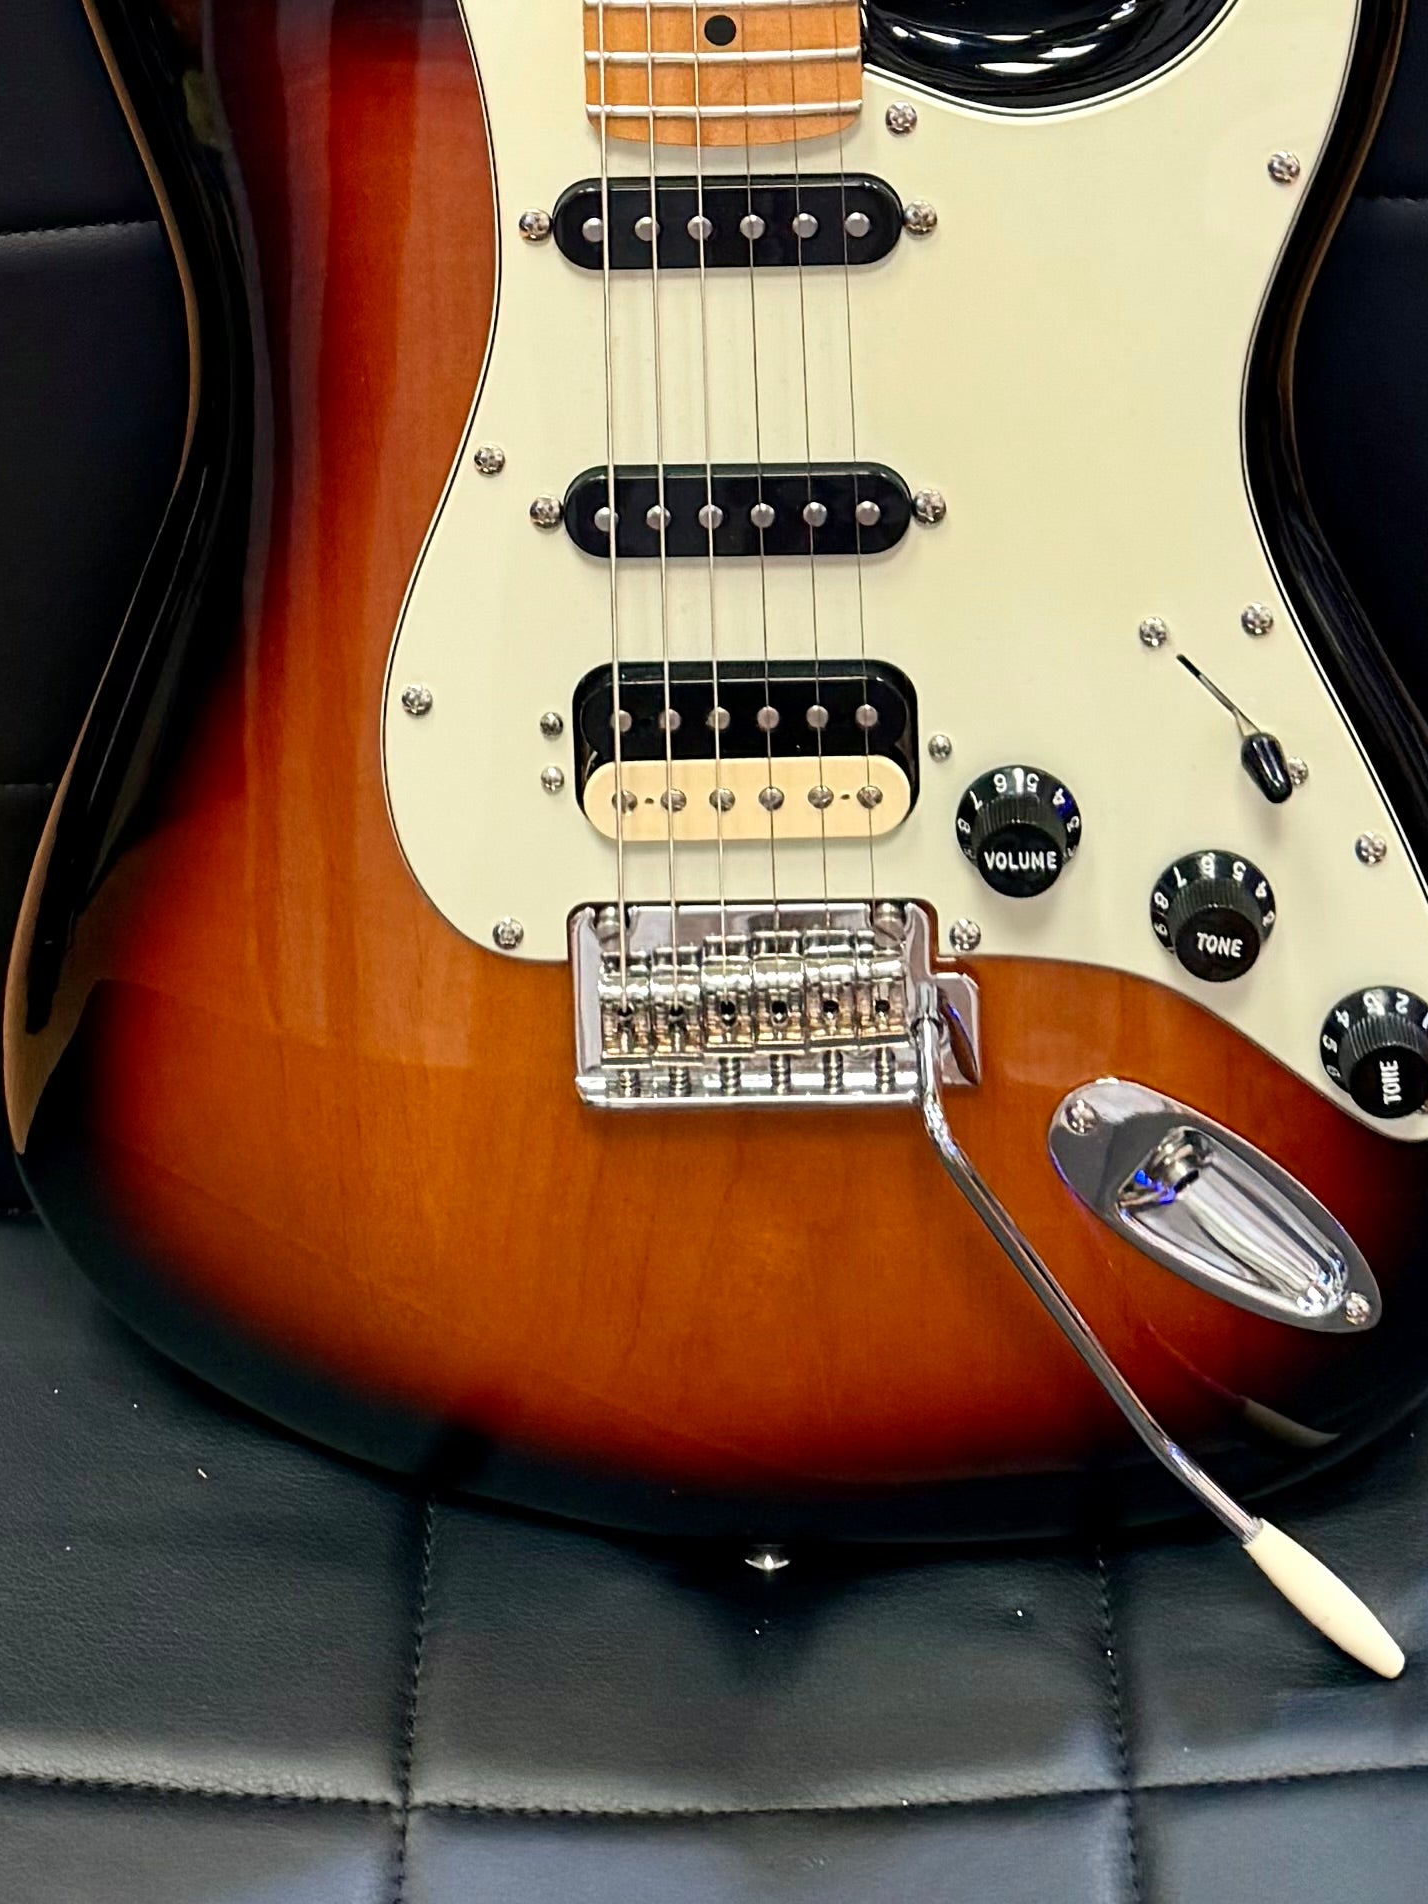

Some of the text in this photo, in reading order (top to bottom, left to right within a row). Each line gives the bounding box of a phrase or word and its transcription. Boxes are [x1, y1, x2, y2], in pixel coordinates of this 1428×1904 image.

[983, 850, 1058, 871] VOLUME
[1196, 931, 1244, 959] TONE
[1378, 1059, 1403, 1106] TONE
